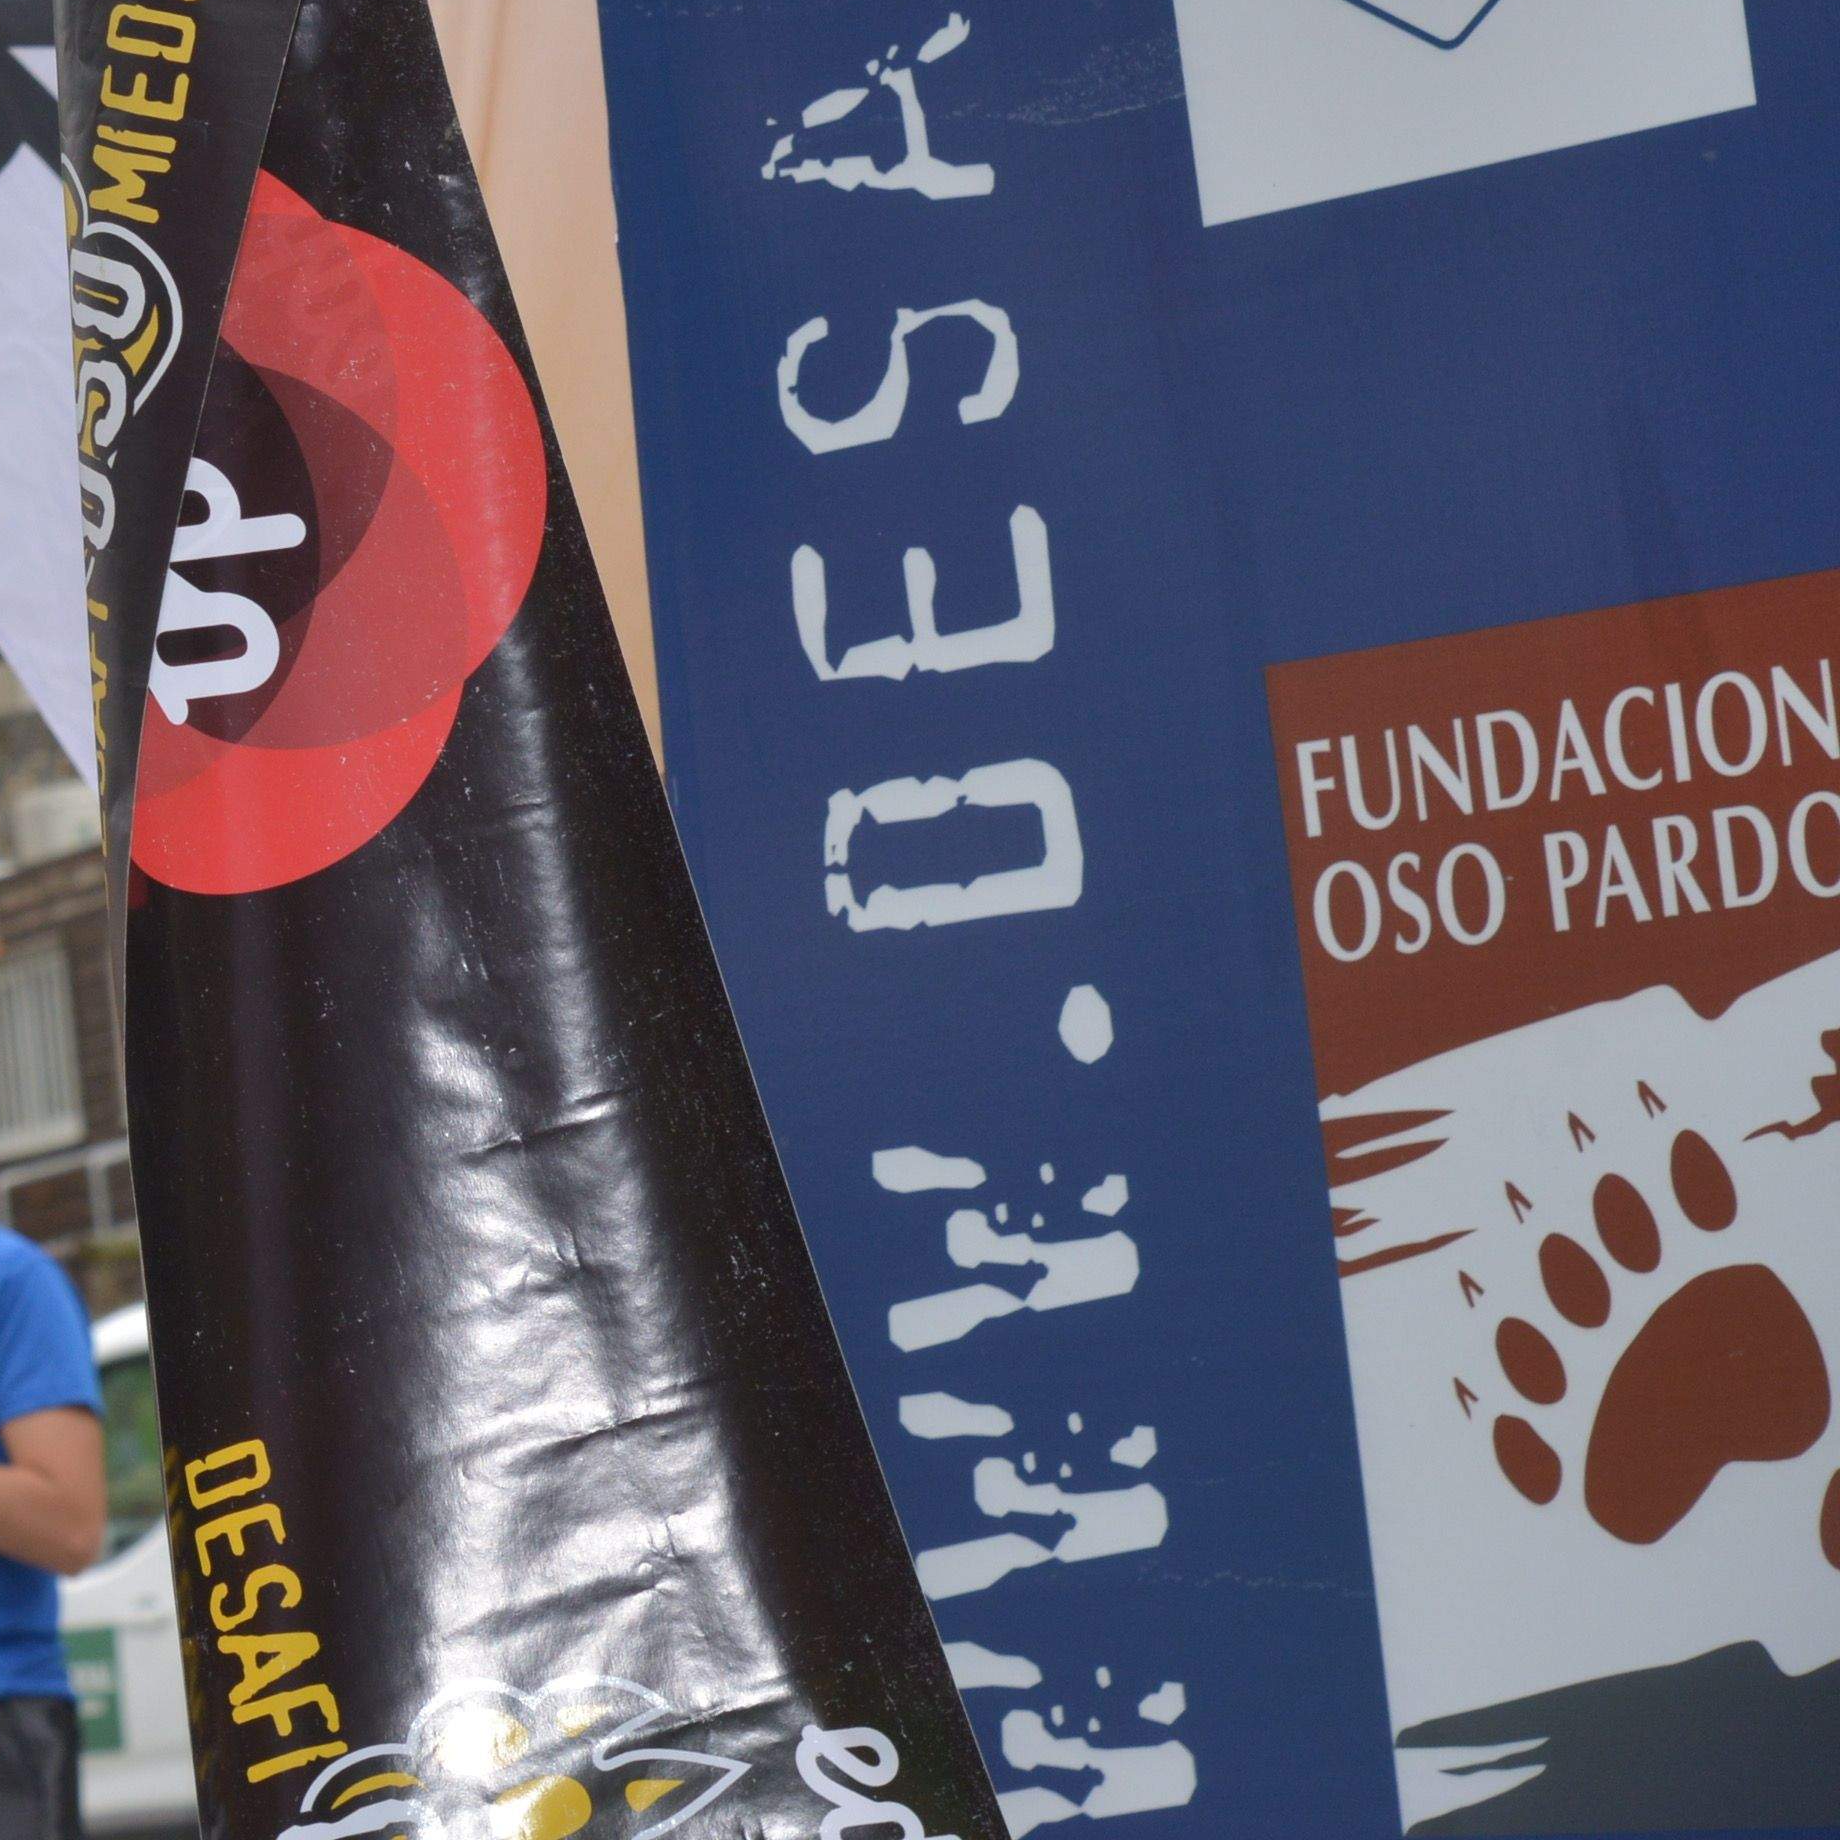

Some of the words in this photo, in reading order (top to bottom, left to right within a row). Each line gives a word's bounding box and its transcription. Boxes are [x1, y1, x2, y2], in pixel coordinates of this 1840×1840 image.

[1296, 657, 1840, 839] FUNDACION
[1312, 842, 1507, 963] OSO
[1542, 790, 1840, 933] PARDO
